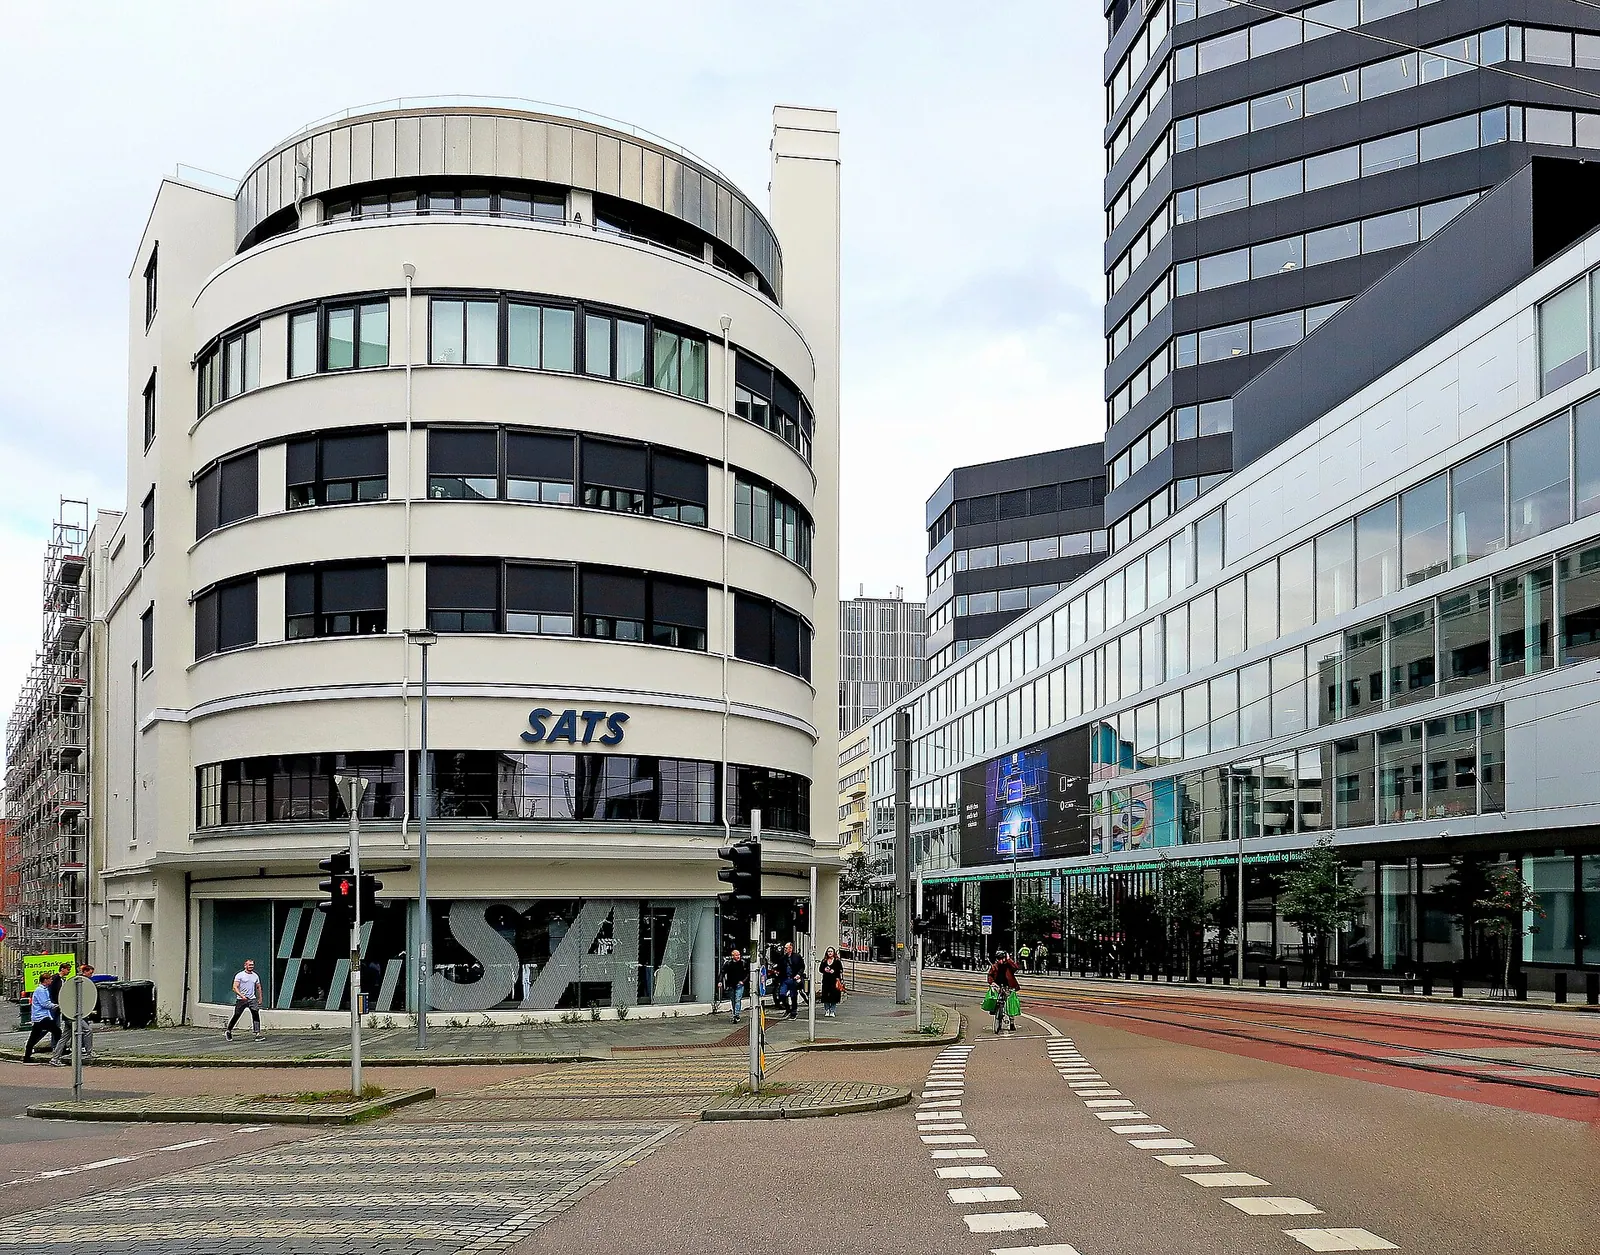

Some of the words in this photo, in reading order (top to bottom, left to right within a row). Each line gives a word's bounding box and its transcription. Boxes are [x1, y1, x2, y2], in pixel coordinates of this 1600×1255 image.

[520, 708, 630, 745] SATS
[1218, 856, 1235, 865] mellom
[1281, 854, 1289, 863] og
